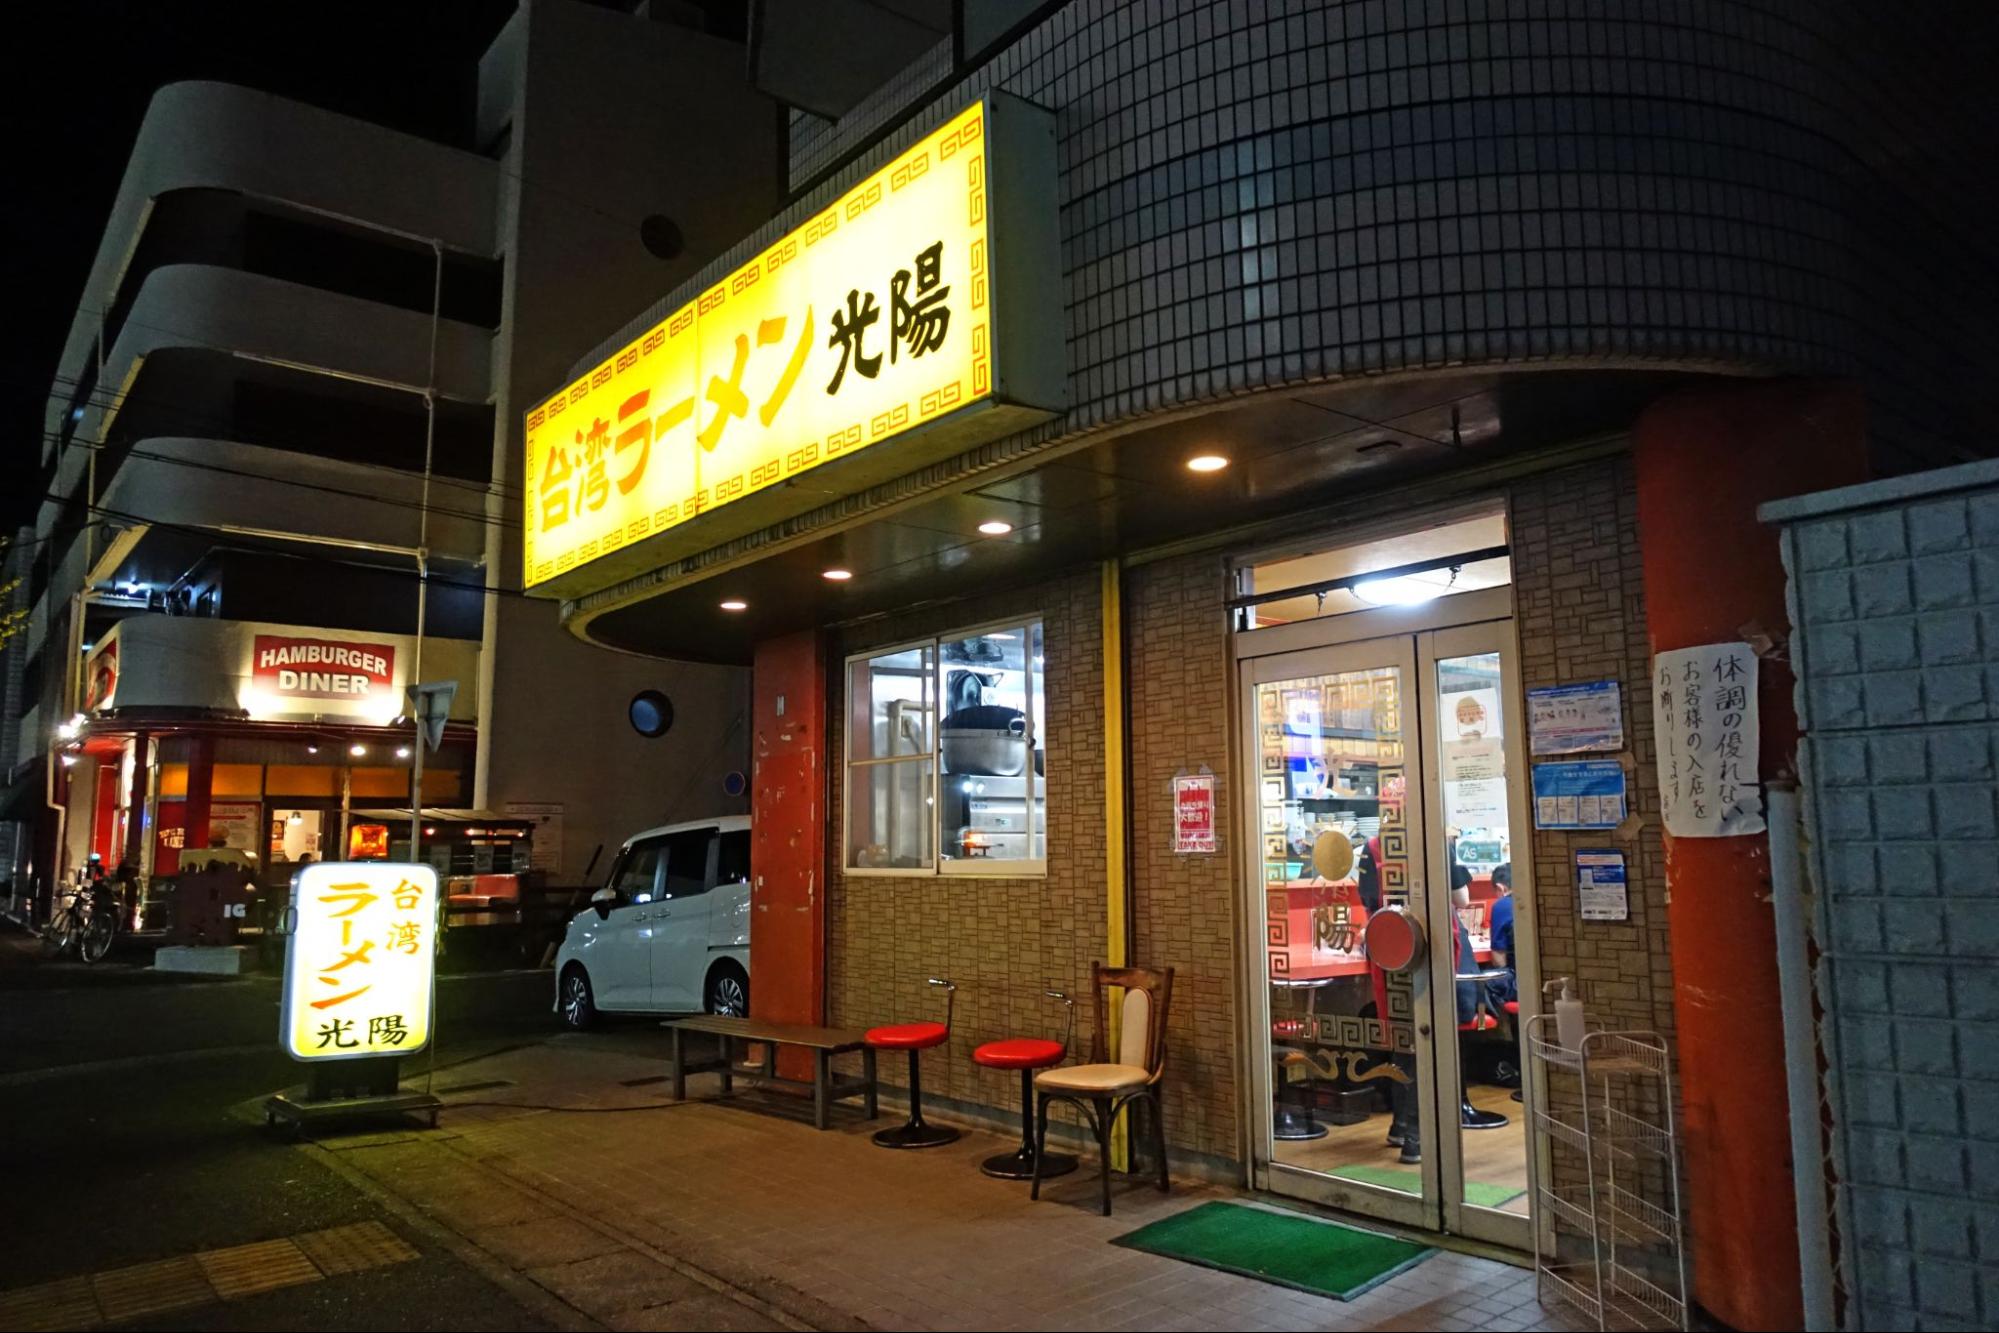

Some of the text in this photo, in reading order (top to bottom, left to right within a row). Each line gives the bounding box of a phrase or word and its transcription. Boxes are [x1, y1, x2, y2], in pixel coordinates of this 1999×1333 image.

[540, 240, 952, 533] 台湾ラーメン 光陽
[260, 645, 388, 677] HAMBURGER
[278, 669, 370, 695] DINER
[1682, 660, 1707, 819] お客様の入店を
[1713, 654, 1746, 822] 体調の優れない
[310, 882, 380, 1010] ラーメン
[386, 879, 424, 955] 台湾
[317, 1015, 409, 1049] 光陽
